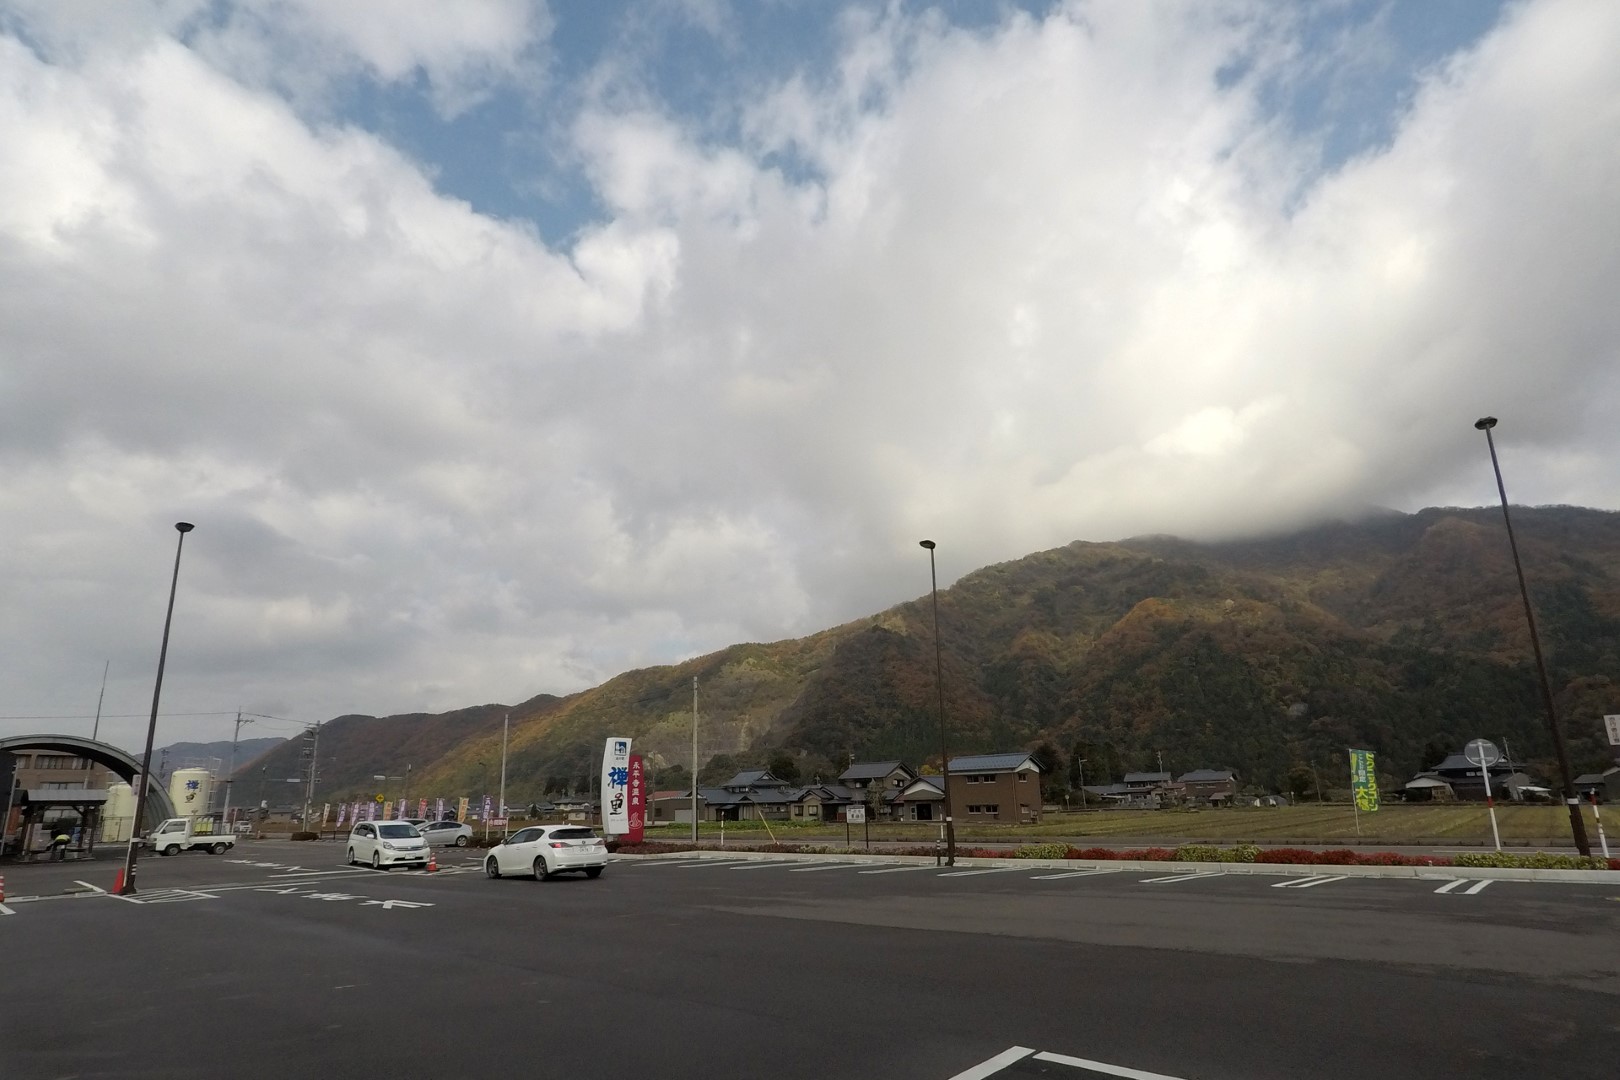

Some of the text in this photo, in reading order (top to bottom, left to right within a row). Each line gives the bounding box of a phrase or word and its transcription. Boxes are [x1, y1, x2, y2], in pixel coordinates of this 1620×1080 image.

[632, 762, 640, 805] 永平寺温泉
